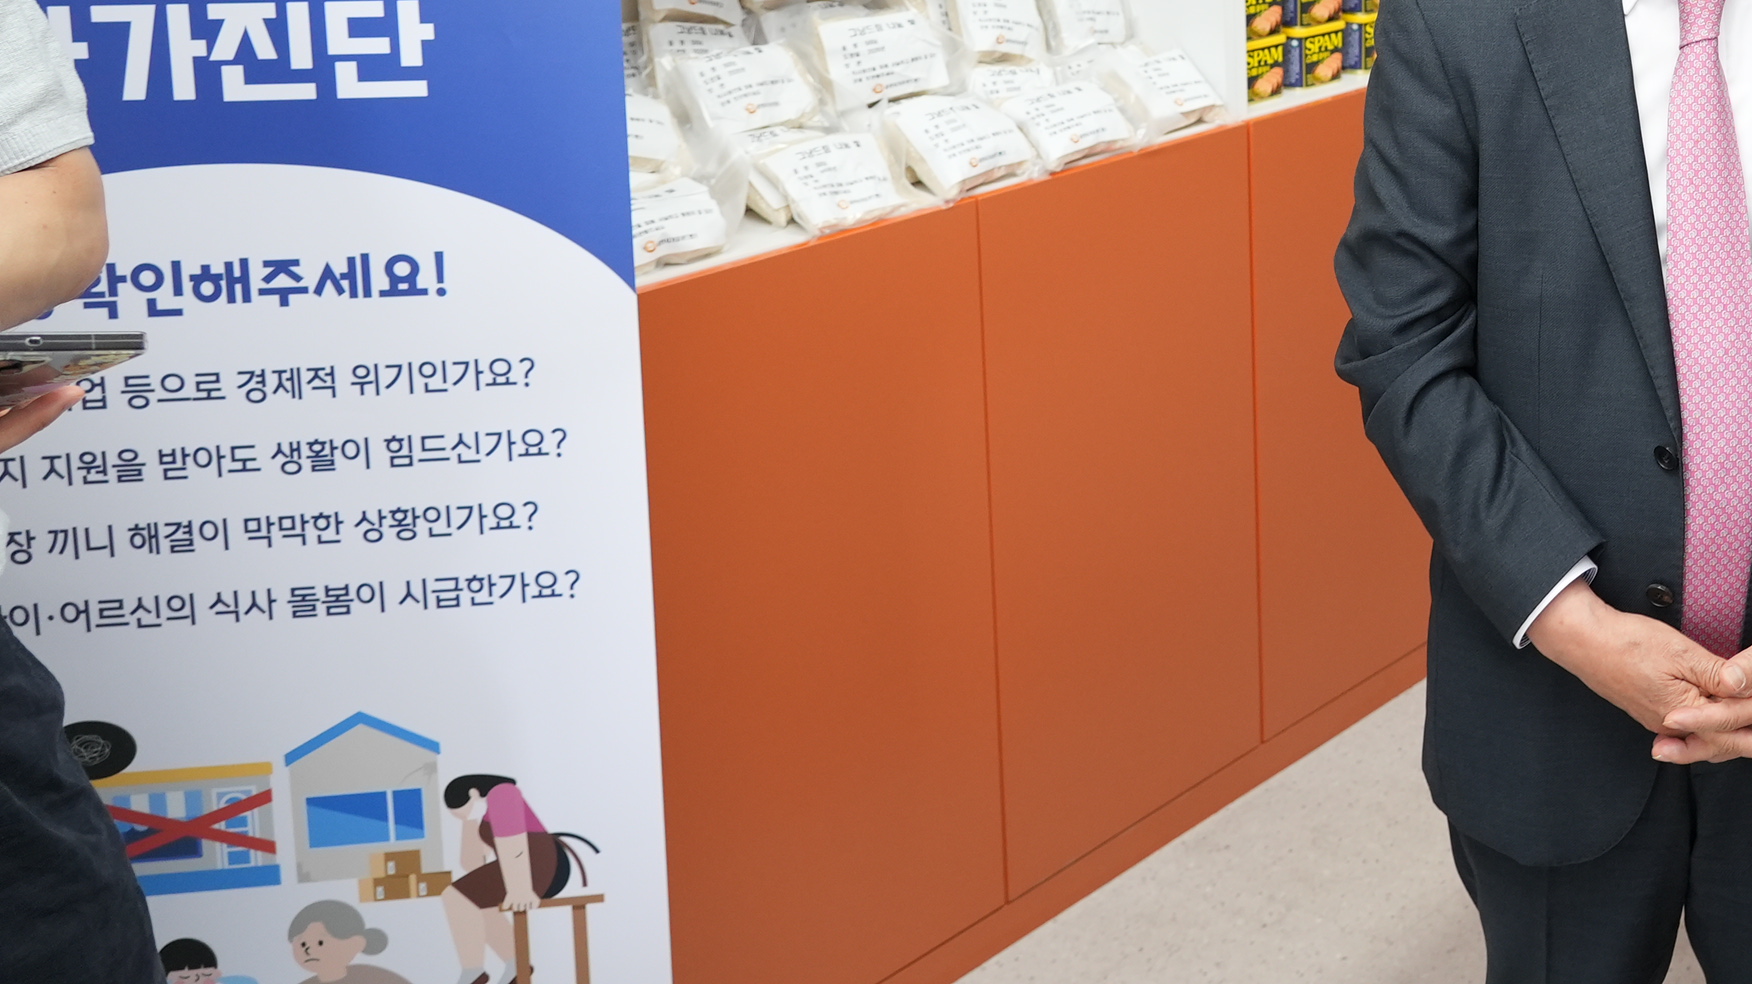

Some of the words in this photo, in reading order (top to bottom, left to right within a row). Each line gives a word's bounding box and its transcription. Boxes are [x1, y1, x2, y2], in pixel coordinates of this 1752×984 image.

[1246, 45, 1284, 67] SPAM
[1305, 32, 1344, 55] SPAM
[120, 370, 227, 410] 등으로
[236, 363, 338, 404] 경제적
[350, 356, 535, 398] 위기인가요?
[41, 447, 147, 487] 지원을
[157, 443, 262, 482] 받아도
[271, 436, 373, 476] 생활이
[383, 428, 568, 472] 힘드신가요?
[47, 524, 116, 561] 끼니
[128, 517, 231, 556] 해결이
[243, 509, 344, 548] 막막한
[354, 501, 539, 544] 상황인가요?
[209, 587, 278, 624] 식사
[286, 579, 387, 620] 돌봄이
[398, 569, 581, 613] 시급한가요?
